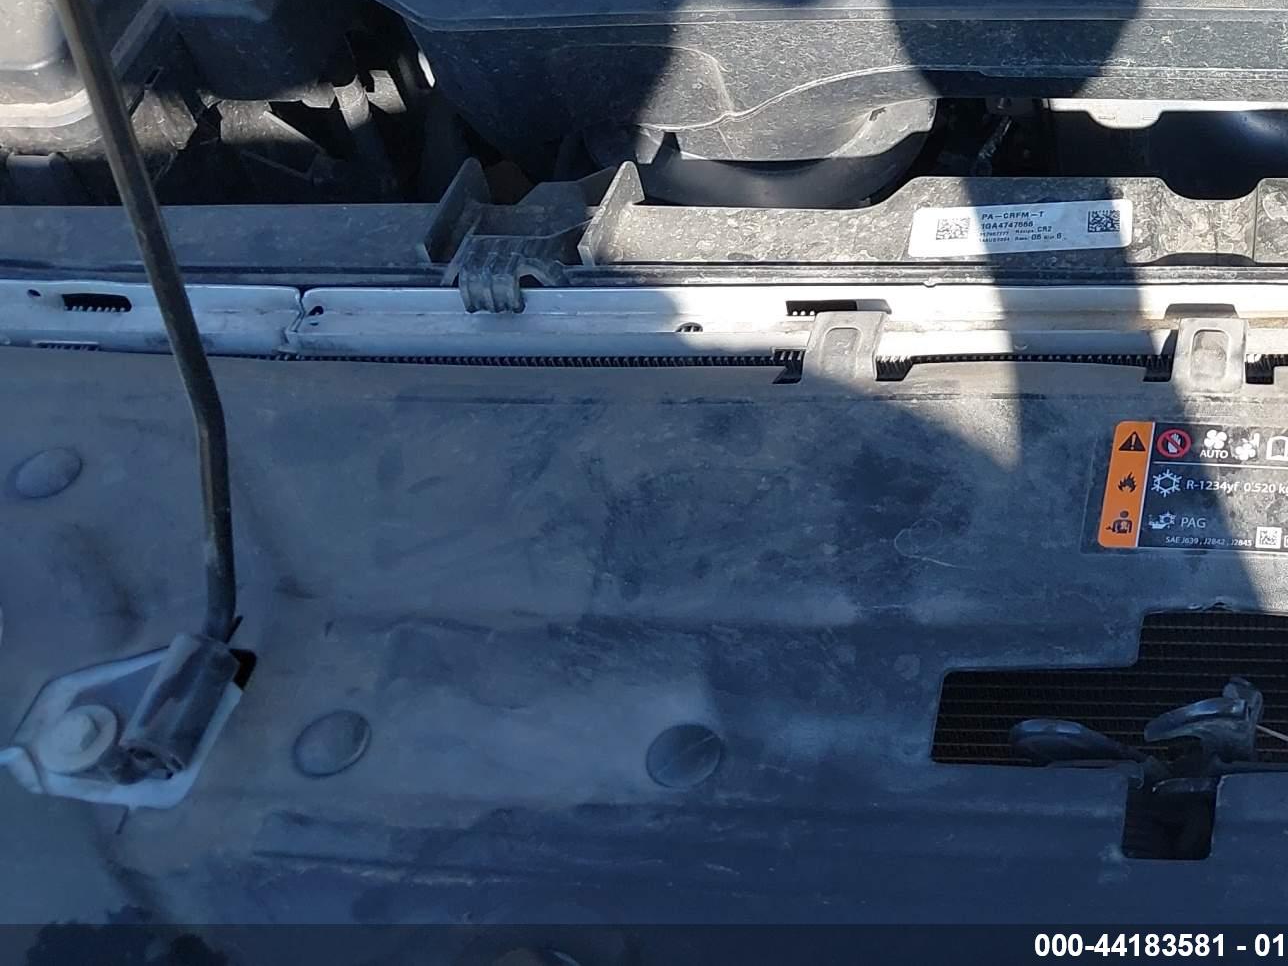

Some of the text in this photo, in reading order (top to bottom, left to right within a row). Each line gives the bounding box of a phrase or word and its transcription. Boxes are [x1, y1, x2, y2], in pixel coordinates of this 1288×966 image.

[1200, 449, 1229, 459] AUTO
[1186, 479, 1240, 493] R-1234yf
[1243, 482, 1276, 494] 0.520
[1180, 517, 1206, 529] PAG
[1165, 536, 1180, 544] SAE
